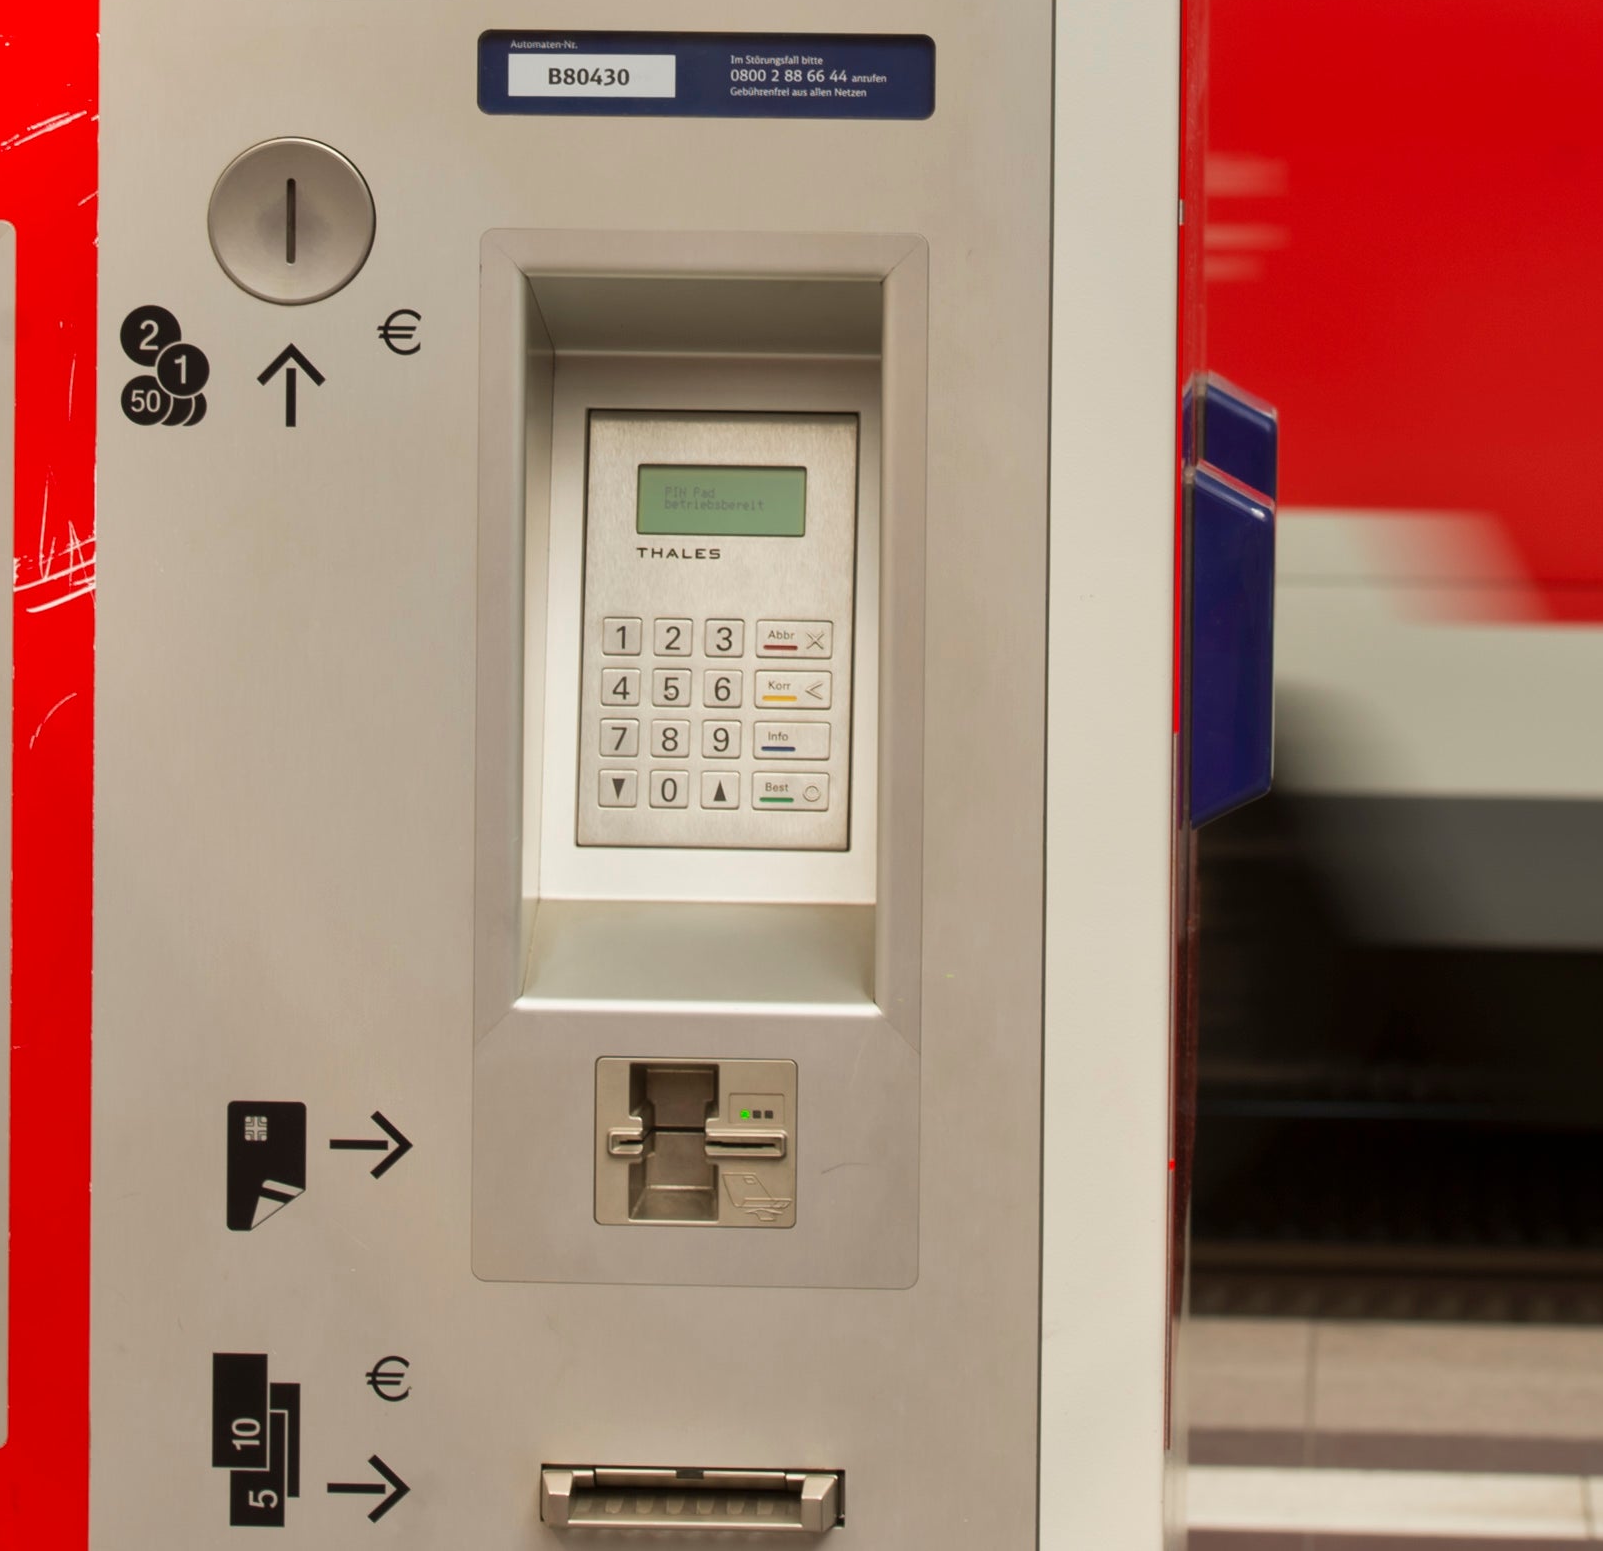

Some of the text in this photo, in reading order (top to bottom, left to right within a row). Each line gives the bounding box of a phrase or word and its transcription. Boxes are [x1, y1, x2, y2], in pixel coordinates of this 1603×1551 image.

[510, 40, 578, 50] Automaten-Nr.
[730, 55, 823, 67] Im Störungsfall bitte
[548, 67, 630, 86] B80430
[730, 69, 887, 83] 0800 2 88 66 44 anrufen
[730, 87, 867, 98] Gebührenfrei aus allen Netzen
[139, 319, 160, 351] 2
[376, 308, 423, 356] €
[173, 354, 187, 385] 1
[130, 390, 161, 413] 50
[665, 487, 716, 498] PIN Pad
[664, 500, 764, 511] betriebsbereit
[636, 548, 721, 559] THALES
[615, 626, 795, 651] 1 2 3 Abbr
[612, 676, 791, 701] 4 5 6 Korr
[610, 727, 789, 752] 7 8 9 Info
[660, 777, 789, 802] 0 Best
[364, 1355, 411, 1402] €
[231, 1417, 261, 1451] 10
[248, 1489, 279, 1509] 5
